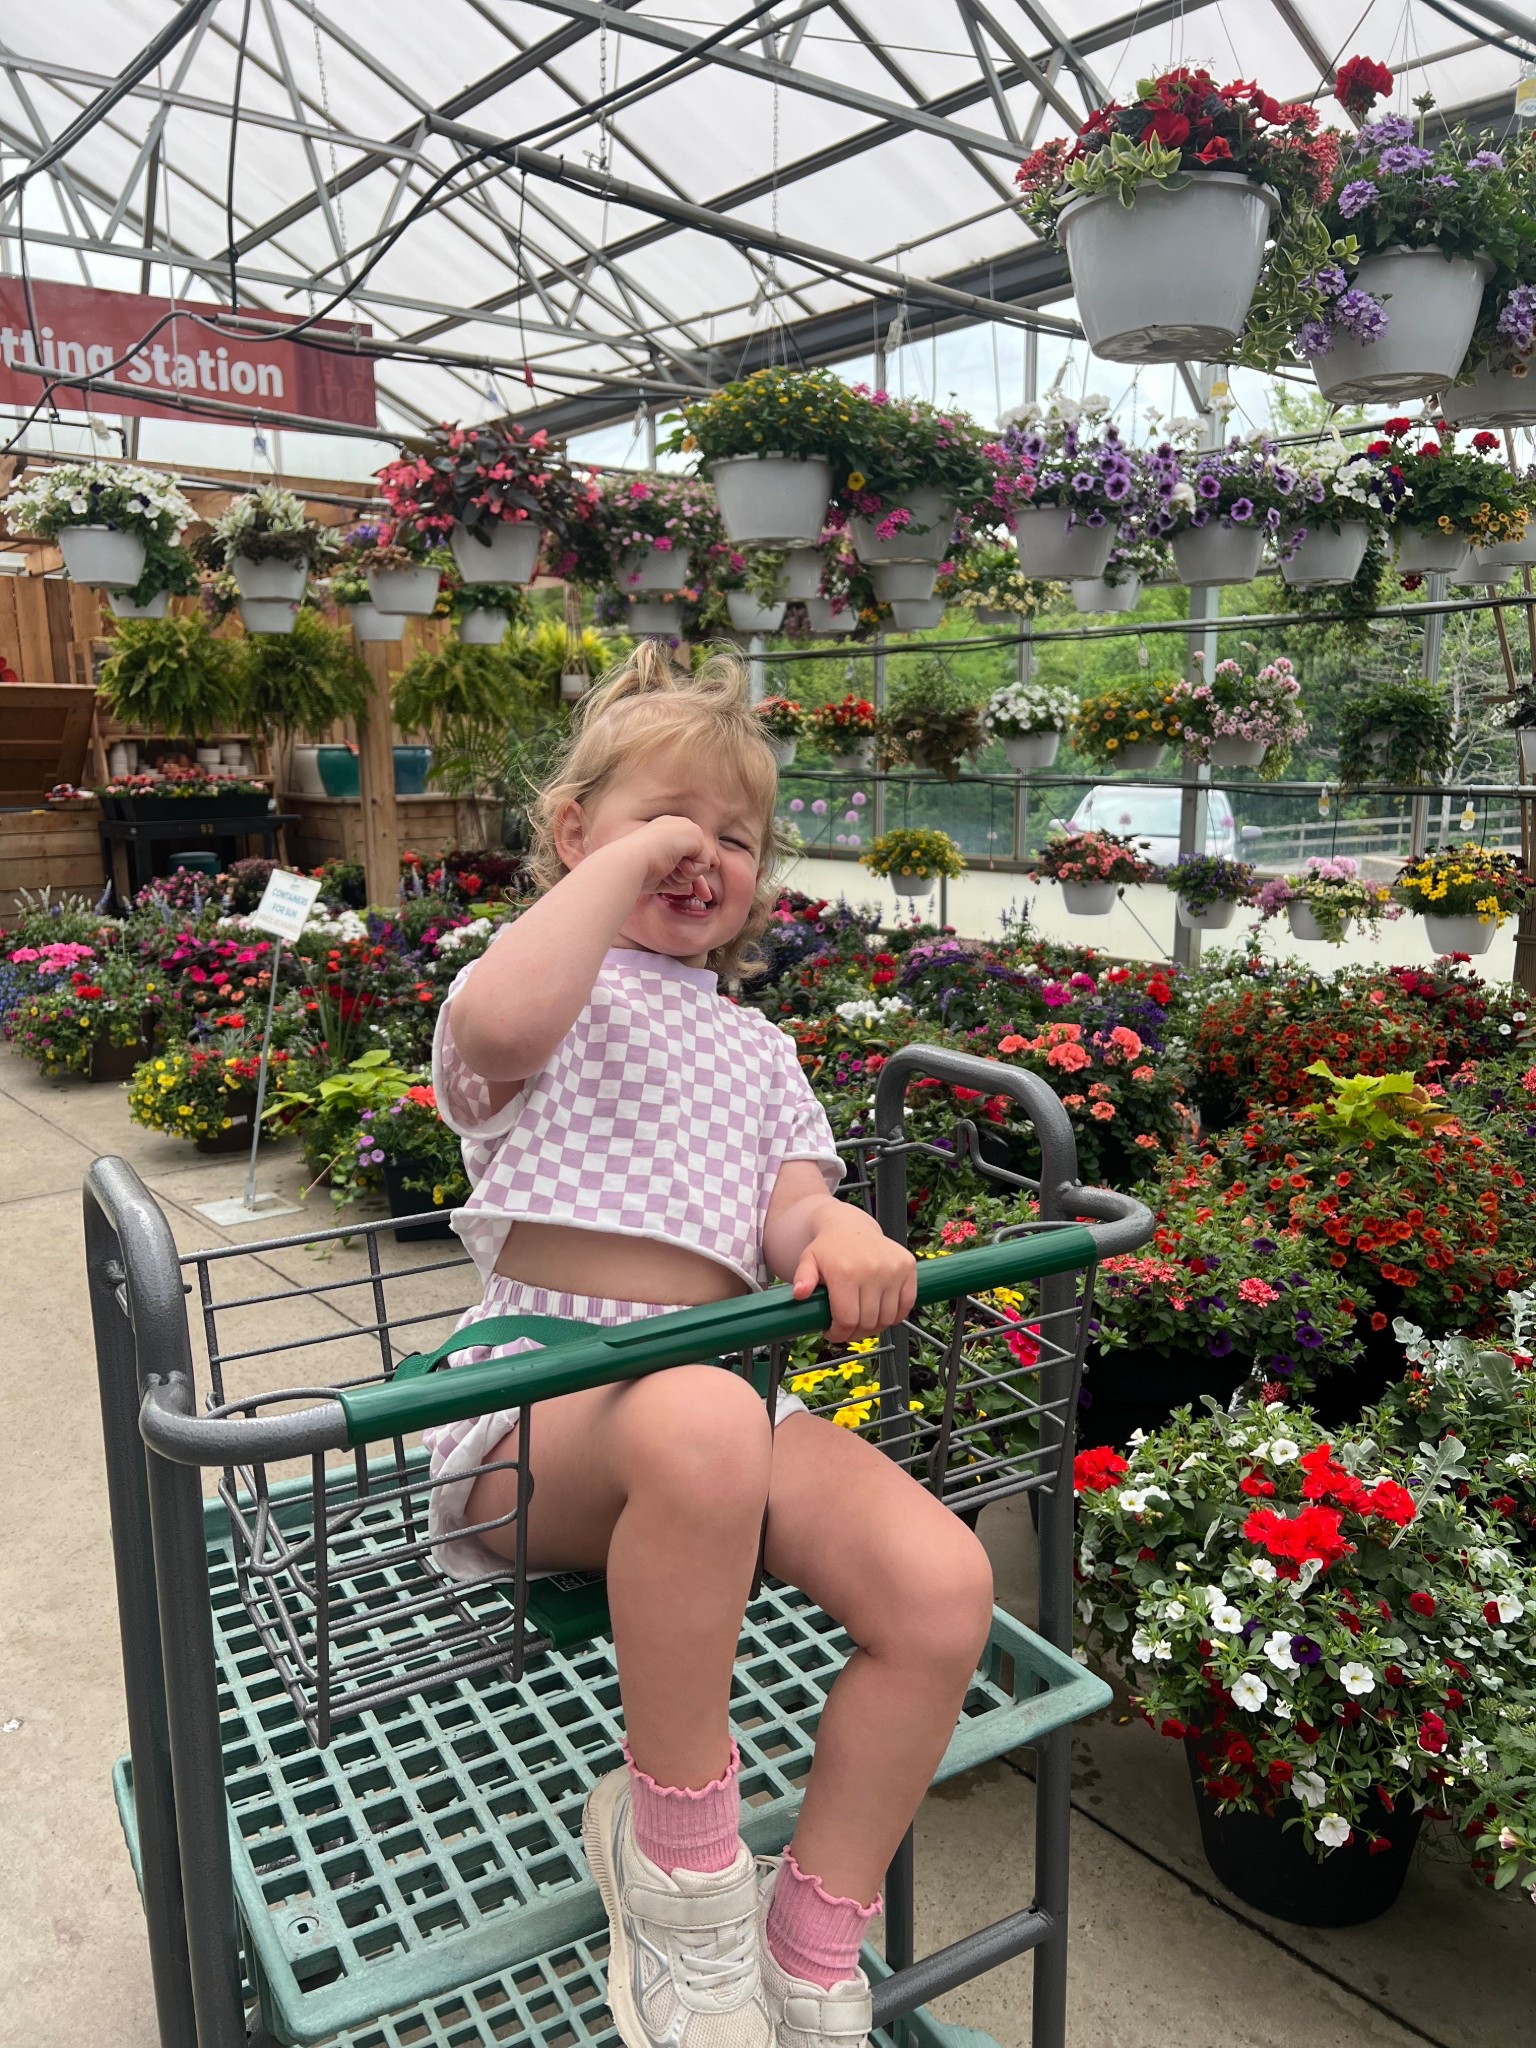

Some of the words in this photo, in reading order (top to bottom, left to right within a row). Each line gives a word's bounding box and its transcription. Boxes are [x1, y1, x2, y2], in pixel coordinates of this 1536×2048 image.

[0, 326, 115, 382] tting
[126, 342, 284, 398] Station
[271, 888, 310, 907] CONTAINERS
[271, 903, 286, 913] FOR
